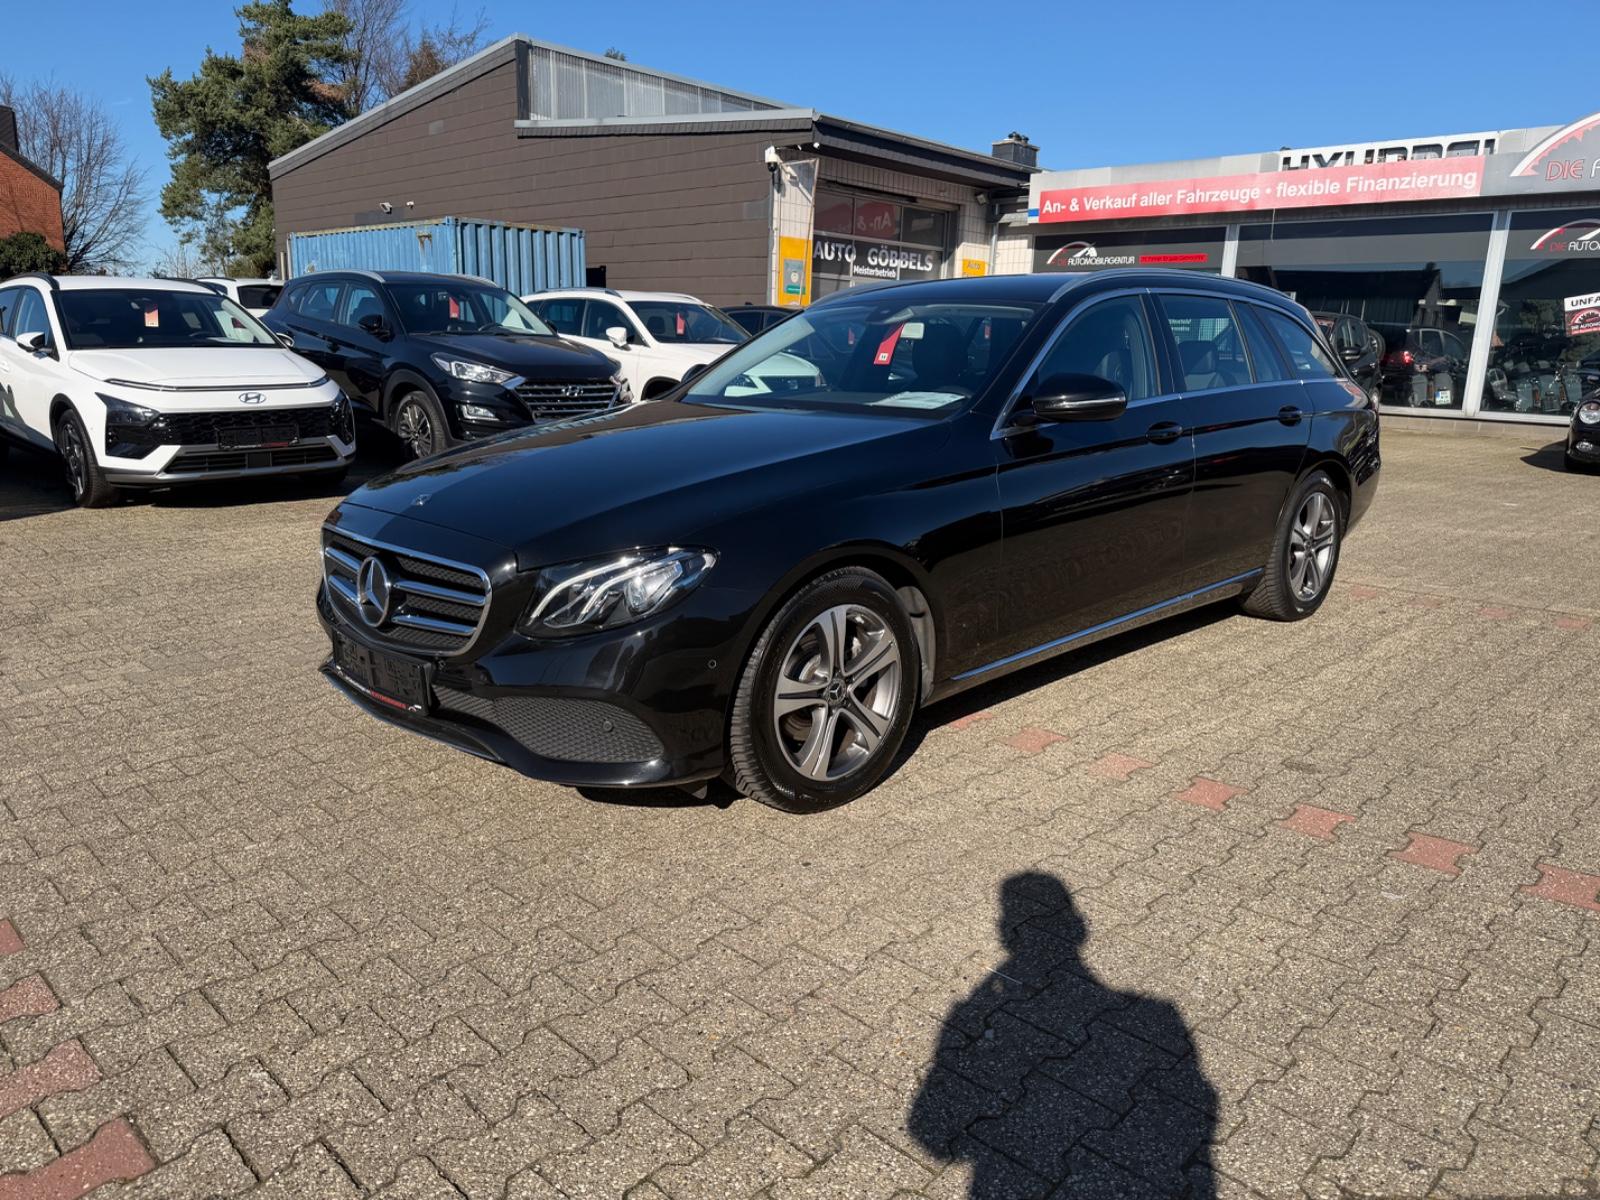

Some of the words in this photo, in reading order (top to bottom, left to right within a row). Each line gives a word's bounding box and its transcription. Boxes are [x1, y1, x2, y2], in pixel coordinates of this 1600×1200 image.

[1546, 159, 1585, 180] DIE
[1042, 199, 1066, 214] An-
[1069, 198, 1080, 212] &
[1083, 193, 1138, 211] Verkauf
[1140, 192, 1172, 207] aller
[1176, 187, 1261, 204] Fahrzeuge
[1276, 179, 1341, 198] flexible
[1346, 171, 1478, 193] Finanzierung
[1549, 242, 1567, 252] DIE
[1568, 240, 1600, 252] AUTO
[813, 241, 857, 263] AUTO
[867, 245, 933, 272] GÖBBELS
[1067, 256, 1136, 266] AUTOMOBILAGENTUR
[853, 265, 897, 278] Meisterbetrieb
